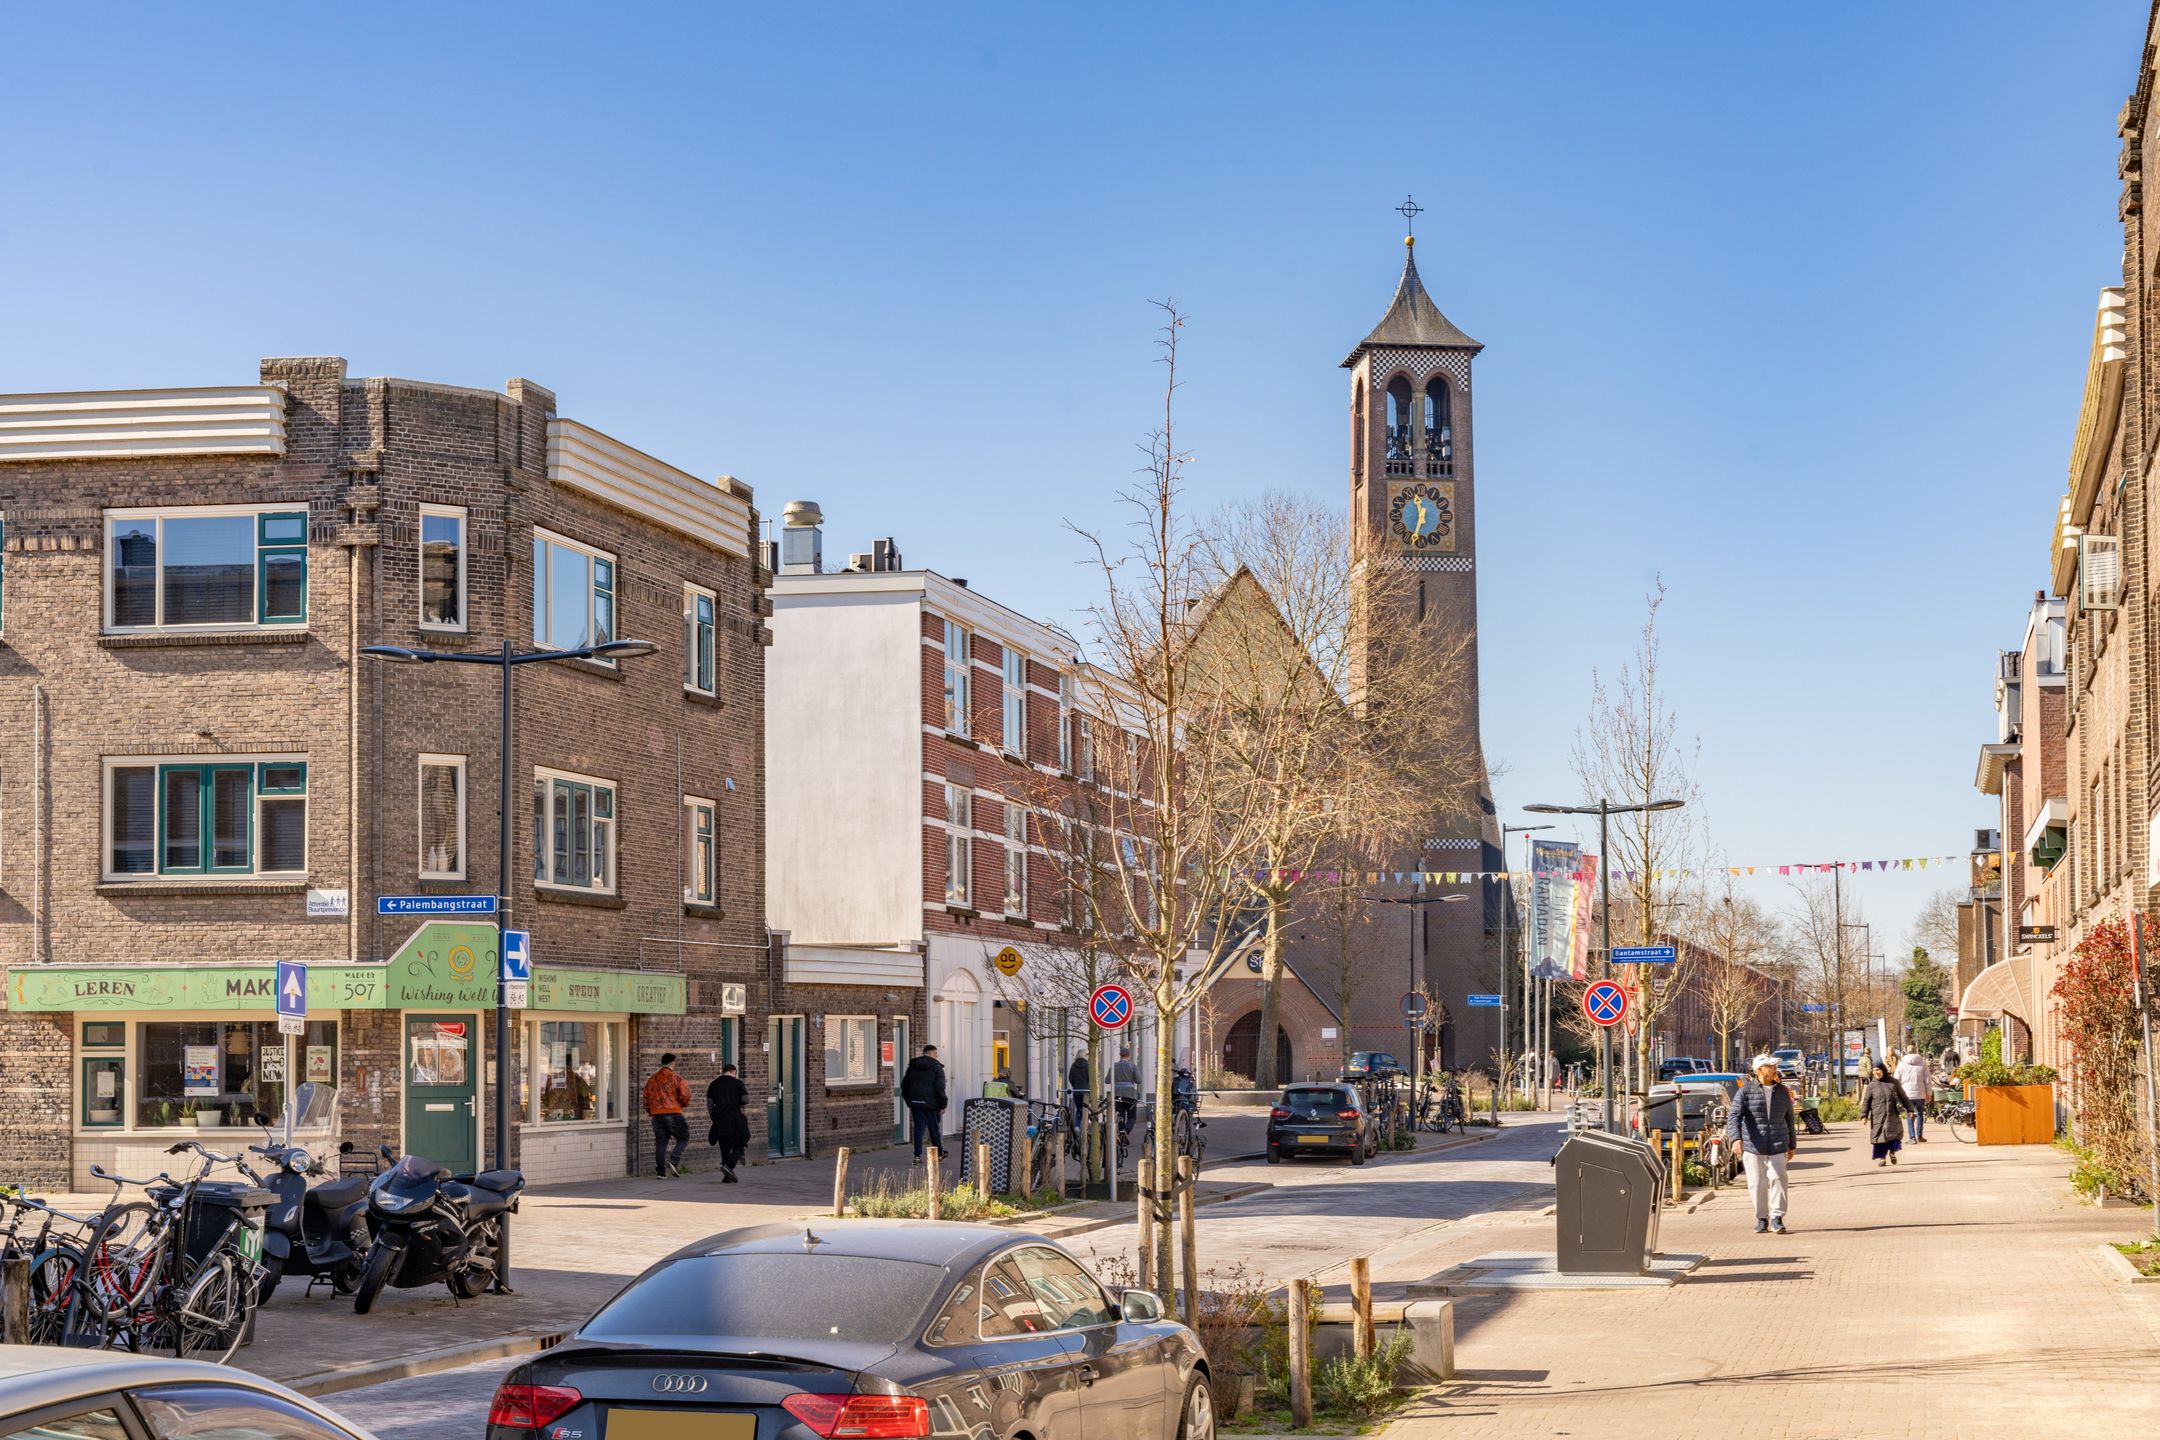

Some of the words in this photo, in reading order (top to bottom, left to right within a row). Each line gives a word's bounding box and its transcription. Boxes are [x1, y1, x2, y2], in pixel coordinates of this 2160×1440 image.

[400, 900, 487, 912] Palembangstraat
[1537, 877, 1551, 946] RAMADAN
[75, 981, 136, 996] LEREN
[344, 984, 376, 1001] 507
[401, 984, 454, 1004] Wishing
[459, 988, 486, 1001] Well
[568, 984, 600, 998] STEUN
[262, 1047, 285, 1056] JUSTICE
[559, 1430, 583, 1439] S5
